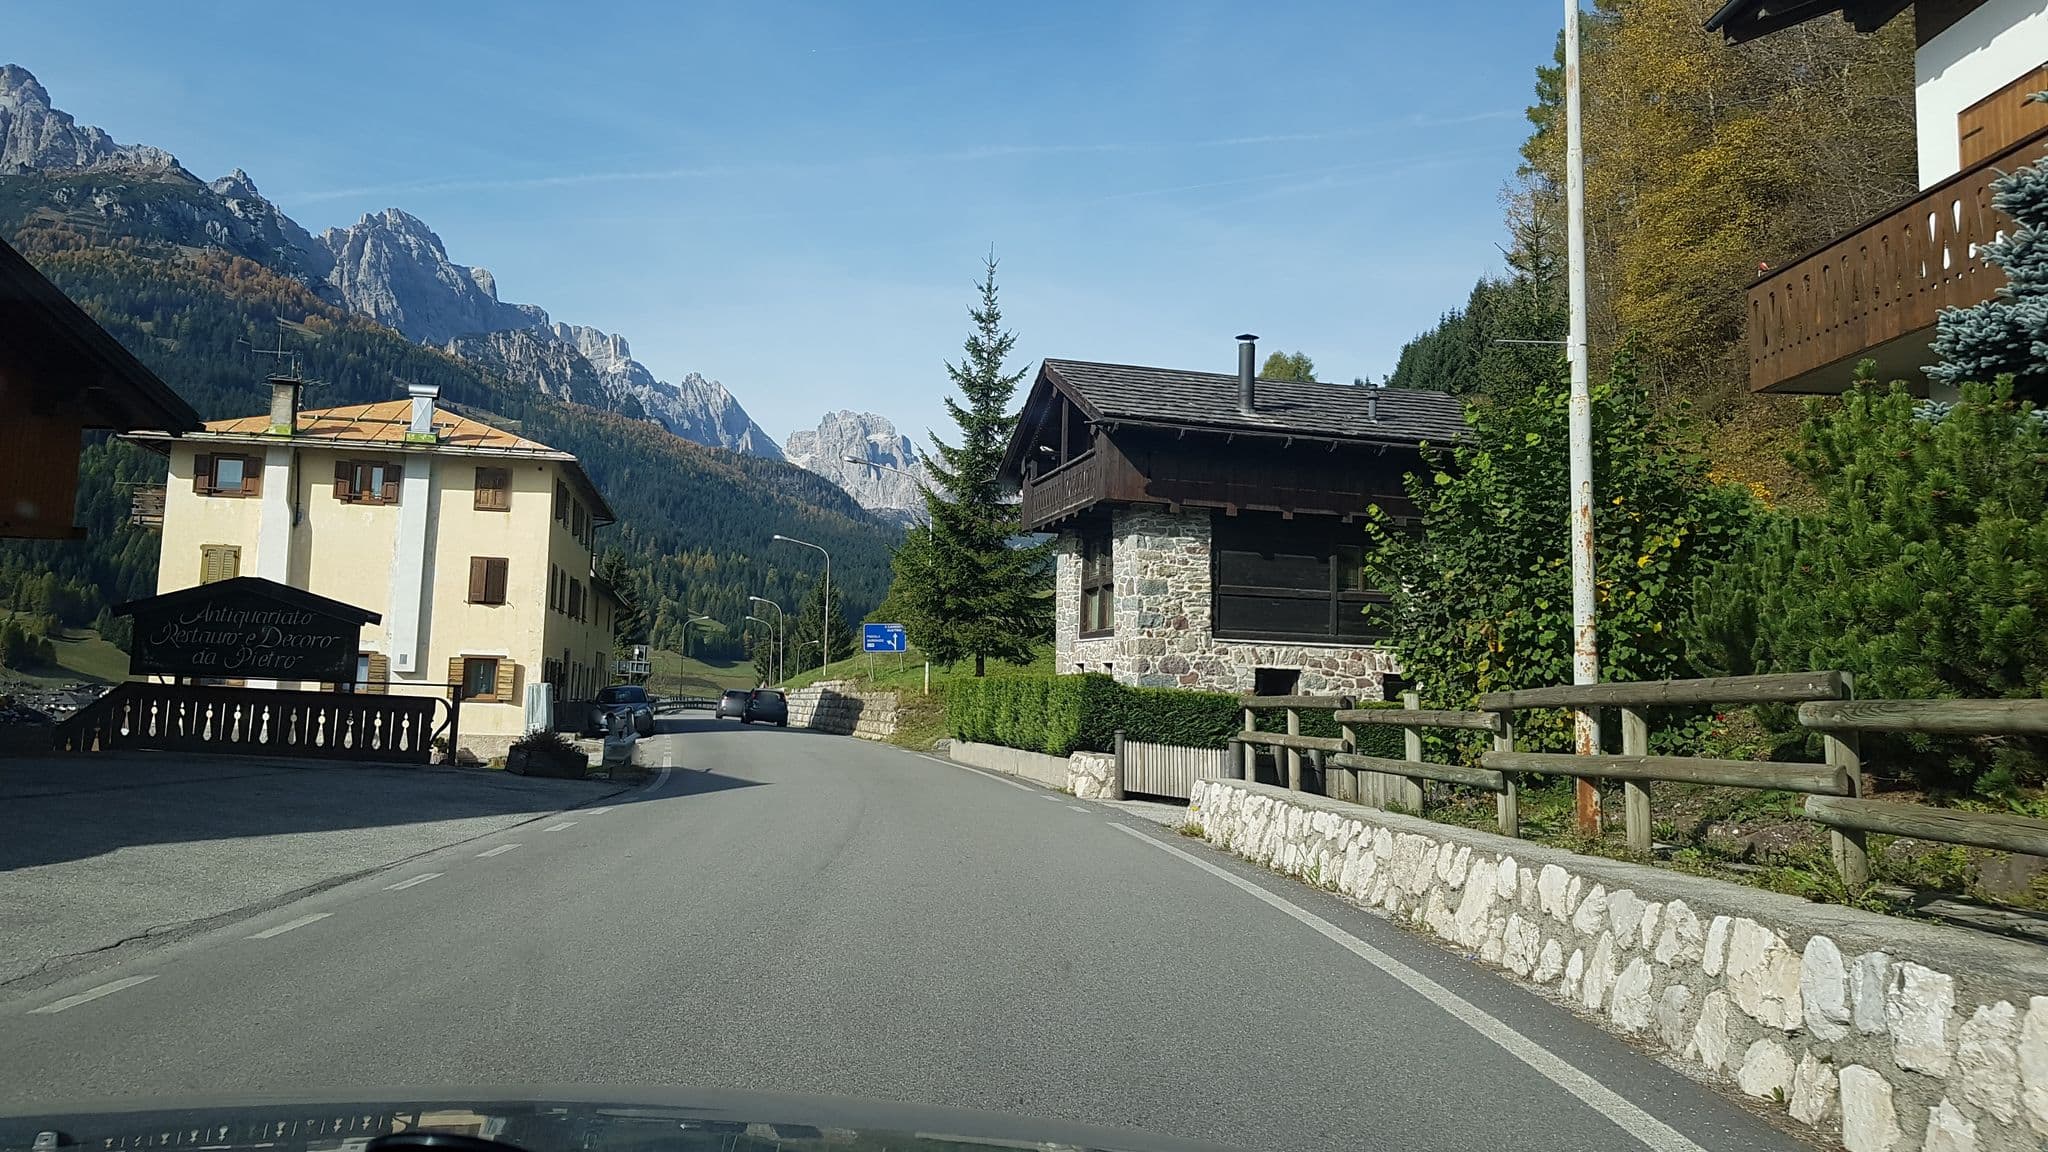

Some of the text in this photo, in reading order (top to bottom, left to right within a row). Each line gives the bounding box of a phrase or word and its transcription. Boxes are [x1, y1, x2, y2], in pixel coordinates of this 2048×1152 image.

[179, 602, 317, 629] Antiquariato
[150, 622, 244, 649] Restauro
[256, 626, 342, 649] Decoro
[191, 645, 304, 669] da Pietro
